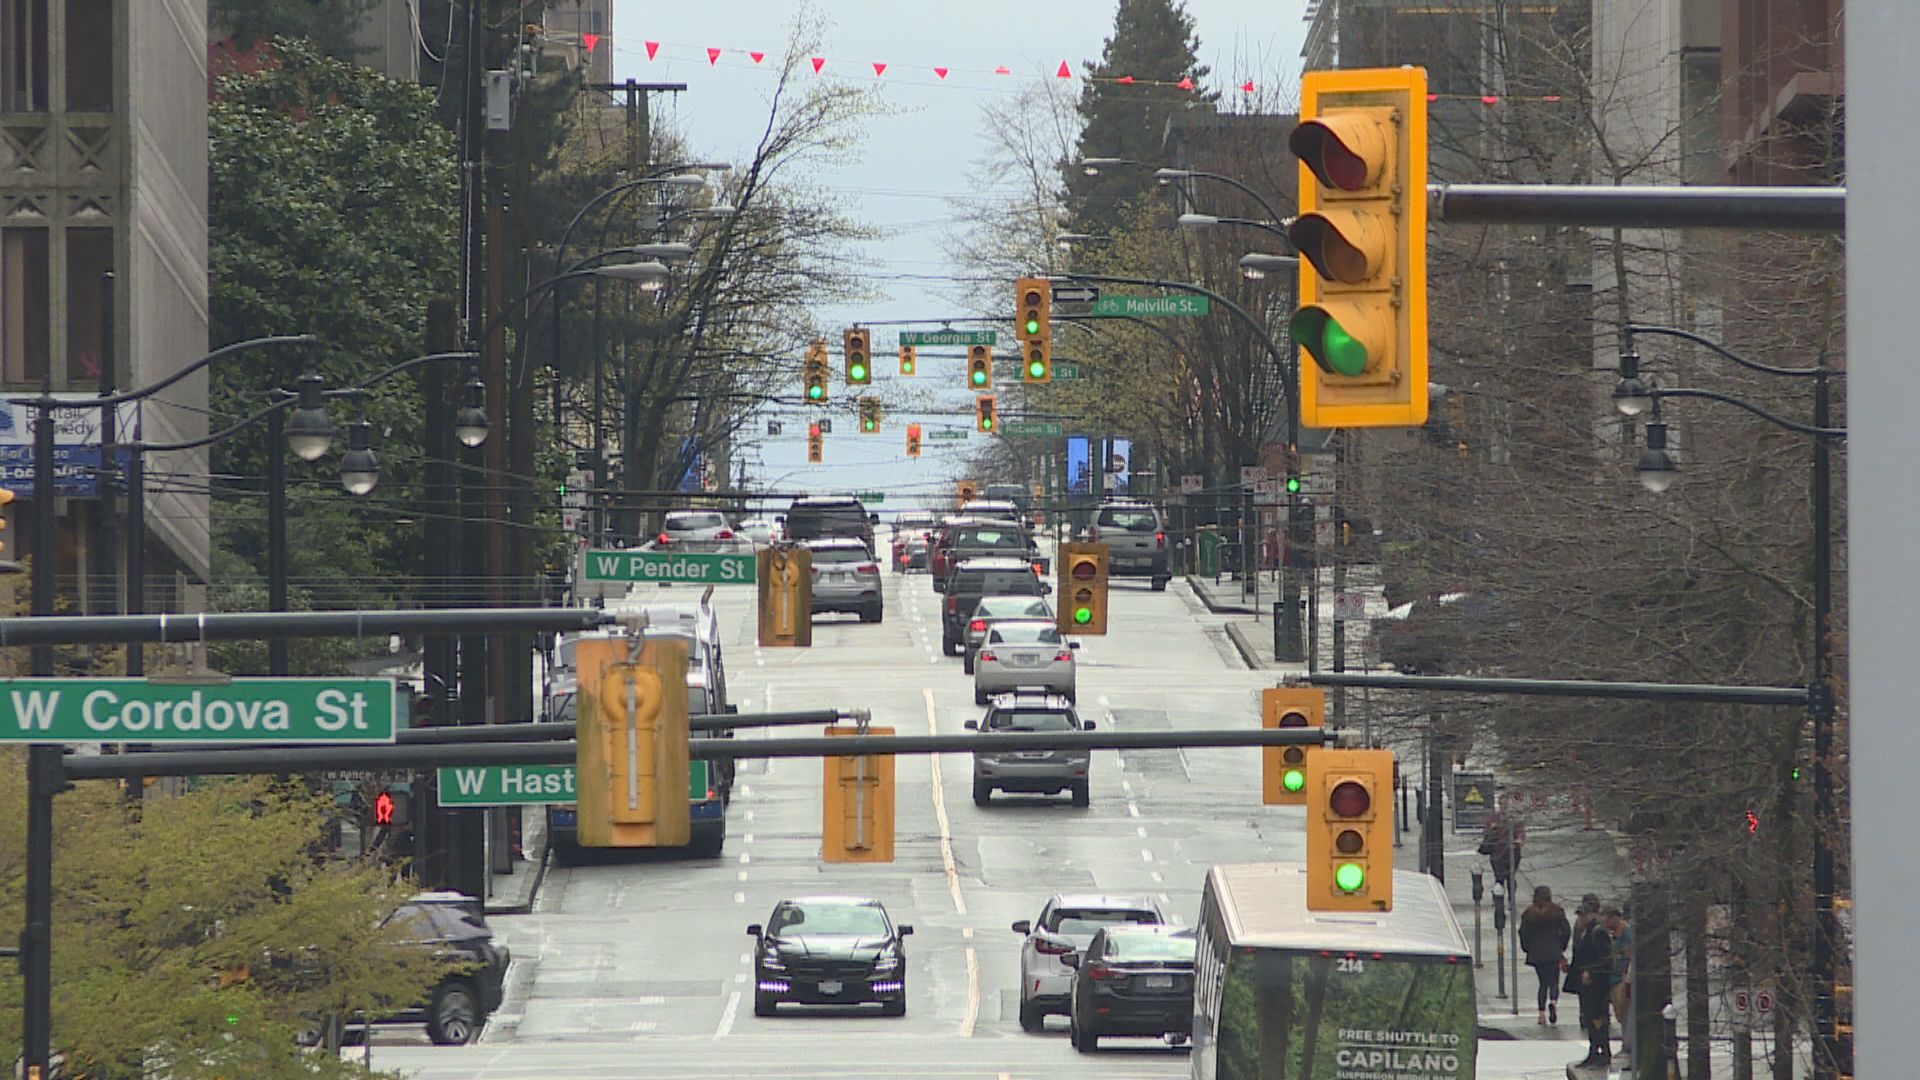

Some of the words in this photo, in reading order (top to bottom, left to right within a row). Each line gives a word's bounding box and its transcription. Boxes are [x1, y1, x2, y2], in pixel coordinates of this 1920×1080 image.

[1127, 299, 1177, 312] Melville
[1180, 299, 1198, 312] St.
[905, 332, 917, 343] W
[922, 333, 971, 345] Georgia
[977, 331, 990, 344] St
[26, 404, 84, 419] Bntall
[26, 419, 94, 439] Knedy
[597, 556, 620, 576] W
[630, 557, 710, 578] Pender
[720, 558, 745, 579] St
[11, 691, 60, 729] W
[82, 690, 290, 731] Cordova
[314, 690, 368, 730] St
[455, 769, 487, 795] W
[501, 768, 575, 794] Hast
[1336, 958, 1364, 973] 214
[1338, 1028, 1373, 1041] FREE
[1376, 1031, 1437, 1044] SHUTTLE
[1441, 1034, 1460, 1045] TO
[1336, 1049, 1459, 1072] CAPILANO
[1336, 1070, 1394, 1080] SUSPENSION
